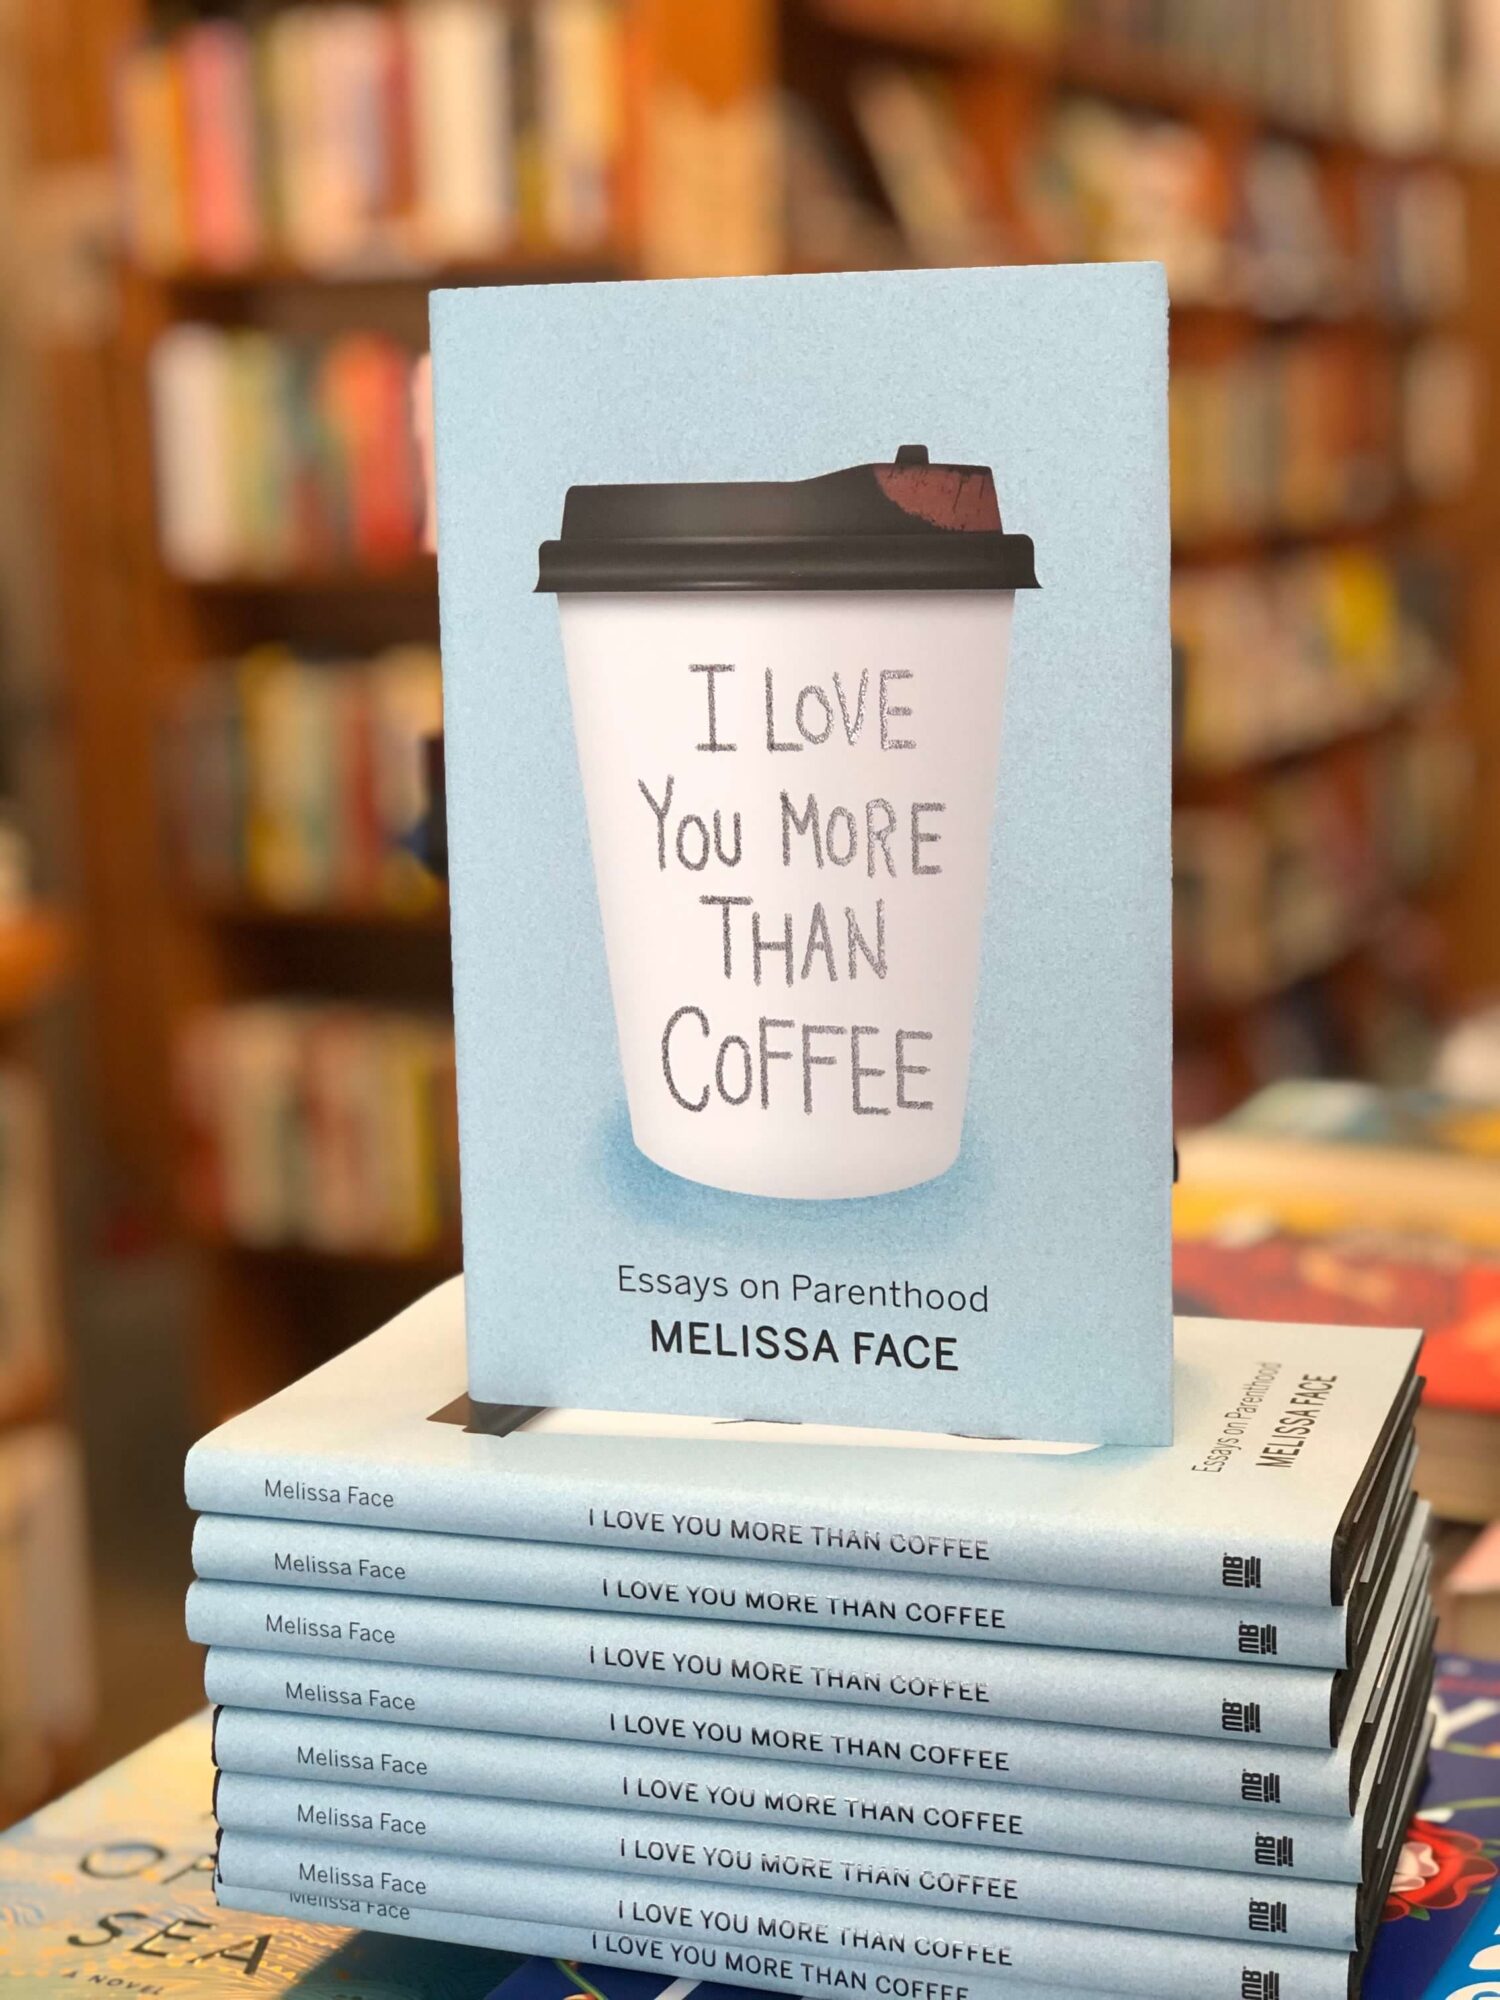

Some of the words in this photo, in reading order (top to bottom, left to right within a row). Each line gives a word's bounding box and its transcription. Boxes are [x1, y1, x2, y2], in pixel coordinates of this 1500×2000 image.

[689, 664, 736, 751] I
[780, 789, 946, 878] MORE
[699, 895, 888, 987] THAN
[617, 1264, 728, 1303] Essays
[740, 1277, 779, 1301] on
[792, 1274, 989, 1313] Parenthood
[650, 1319, 839, 1364] MELISSA
[853, 1332, 959, 1371] FACE
[1224, 1361, 1282, 1420] Parenthood
[1223, 1421, 1249, 1435] on
[1255, 1409, 1321, 1468] MELISSA
[1290, 1374, 1337, 1406] FACE
[1191, 1437, 1242, 1473] Essays
[265, 1479, 341, 1503] Melissa
[348, 1486, 394, 1508] Face
[604, 1510, 664, 1532] LOVE
[672, 1514, 721, 1537] YOU
[731, 1519, 803, 1544] MORE
[811, 1526, 880, 1551] THAN
[890, 1533, 989, 1560] COFFEE
[275, 1552, 352, 1576] Melissa
[359, 1559, 406, 1580] Face
[266, 1614, 342, 1639] Melissa
[350, 1622, 396, 1644] Face
[617, 1580, 679, 1602] LOVE
[686, 1586, 735, 1606] YOU
[745, 1590, 818, 1613] MORE
[826, 1597, 896, 1620] THAN
[906, 1603, 1006, 1628] COFFEE
[286, 1681, 362, 1706] Melissa
[369, 1689, 416, 1711] Face
[604, 1647, 665, 1670] LOVE
[672, 1653, 721, 1676] YOU
[731, 1659, 803, 1684] MORE
[811, 1667, 880, 1692] THAN
[890, 1675, 989, 1702] COFFEE
[297, 1746, 374, 1770] Melissa
[381, 1753, 428, 1776] Face
[625, 1714, 686, 1738] LOVE
[692, 1720, 742, 1744] YOU
[751, 1727, 823, 1752] MORE
[831, 1736, 900, 1760] THAN
[910, 1744, 1010, 1771] COFFEE
[297, 1803, 373, 1830] Melissa
[380, 1812, 427, 1835] Face
[638, 1778, 699, 1802] LOVE
[706, 1785, 755, 1808] YOU
[765, 1790, 837, 1816] MORE
[844, 1798, 914, 1824] THAN
[924, 1807, 1023, 1835] COFFEE
[299, 1862, 374, 1889] Melissa
[381, 1872, 426, 1895] Face
[635, 1840, 695, 1864] LOVE
[703, 1846, 751, 1870] YOU
[761, 1853, 832, 1879] MORE
[840, 1861, 910, 1888] THAN
[919, 1869, 1018, 1900] COFFEE
[67, 1912, 273, 1976] SEA
[633, 1902, 693, 1927] LOVE
[700, 1909, 748, 1934] YOU
[758, 1917, 829, 1944] MORE
[837, 1926, 905, 1953] THAN
[914, 1936, 1013, 1966] COFFEE
[88, 1974, 164, 1996] NOVEL
[606, 1935, 664, 1960] LOVE
[671, 1943, 716, 1968] YOU
[725, 1951, 793, 1979] MORE
[800, 1963, 866, 1991] THAN
